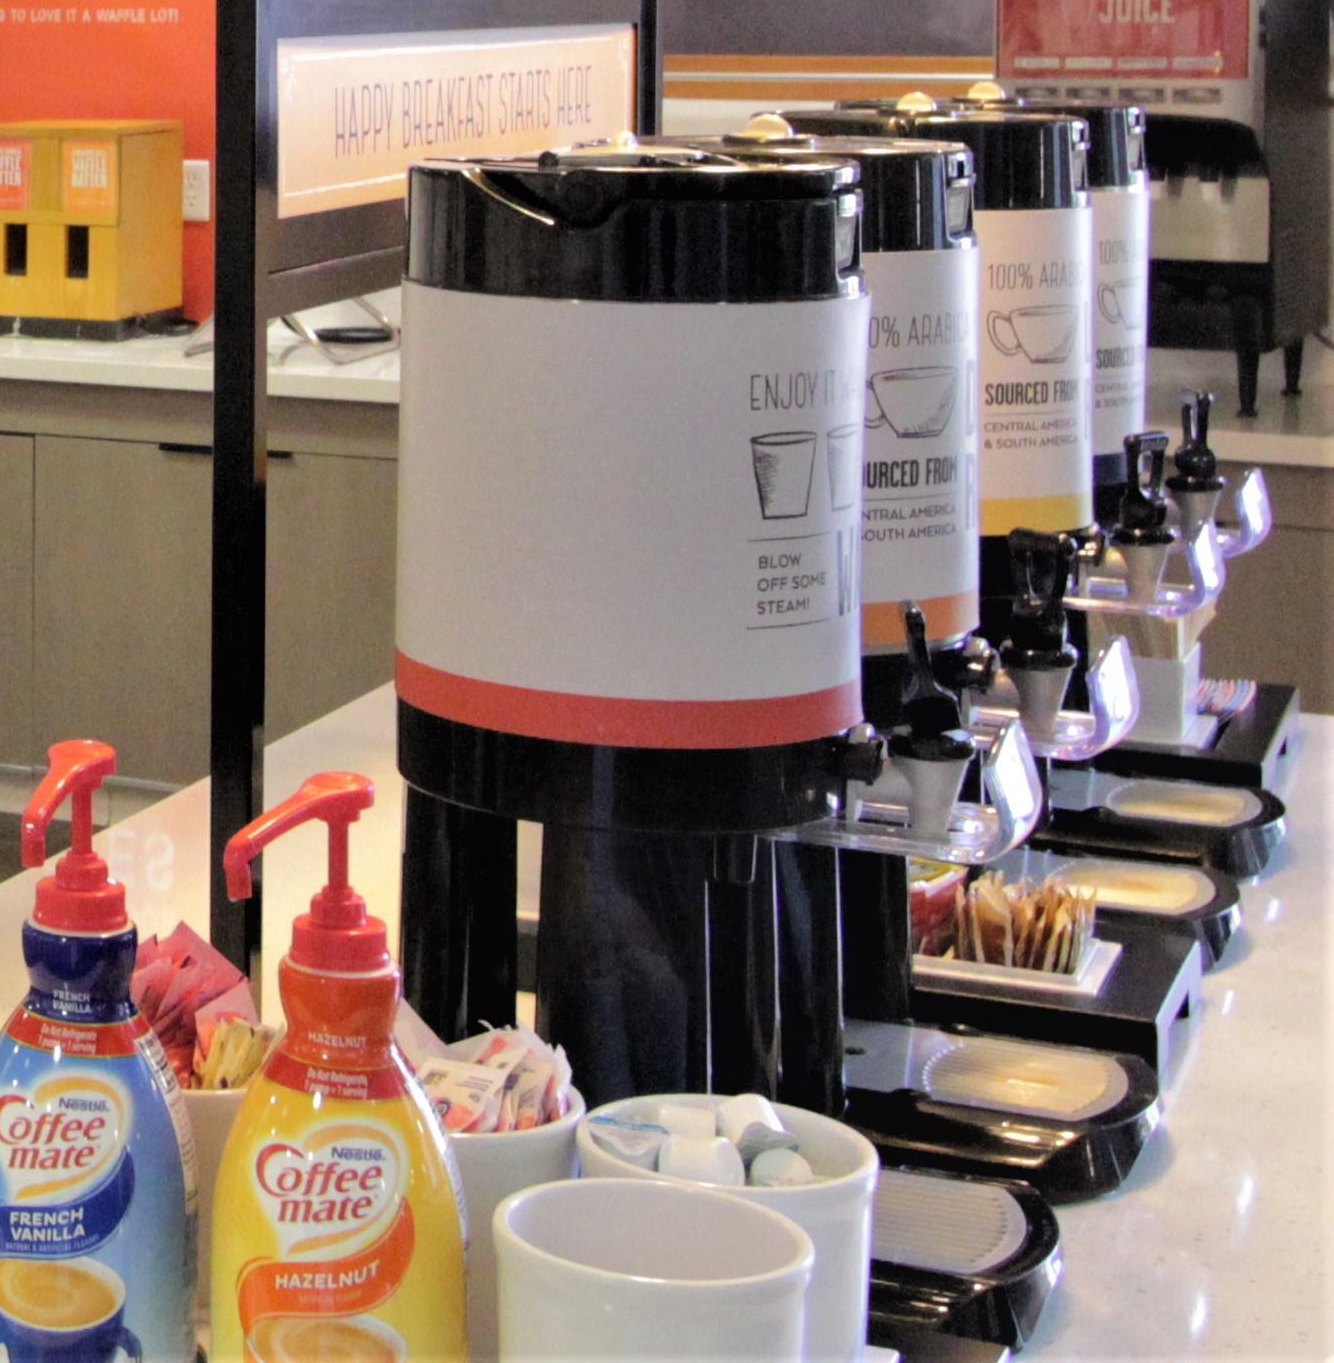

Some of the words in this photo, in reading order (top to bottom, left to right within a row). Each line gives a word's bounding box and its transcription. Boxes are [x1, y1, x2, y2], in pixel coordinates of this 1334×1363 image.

[10, 9, 26, 24] TO
[30, 8, 62, 24] LOVE
[66, 8, 77, 24] IT
[82, 9, 92, 23] A
[96, 8, 146, 24] WAFFLE
[334, 84, 393, 158] HAPPY
[402, 74, 492, 149] BREAKFAST
[498, 69, 551, 134] STARTS
[557, 65, 593, 126] HERE
[987, 263, 1033, 291] 100%
[750, 372, 818, 411] ENJOY
[984, 382, 1049, 406] SOURCED
[984, 419, 1038, 433] CENTRAL
[984, 438, 993, 450] &
[996, 436, 1036, 449] SOUTH
[925, 456, 958, 485] FROM
[909, 502, 956, 520] AMERICA
[908, 522, 957, 539] AMERICA
[758, 553, 802, 570] BLOW
[757, 576, 787, 592] OFF
[792, 572, 826, 589] SOME
[757, 598, 810, 615] STEAM!
[53, 990, 90, 1002] FRENCH
[53, 999, 92, 1014] VANILLA
[308, 1031, 366, 1049] HAZELNUT
[8, 1144, 96, 1170] mate
[256, 1143, 383, 1197] Coffee
[9, 1207, 84, 1227] FRENCH
[278, 1195, 373, 1223] mate
[10, 1224, 86, 1242] VANILLA
[275, 1259, 381, 1290] HAZELNUT
